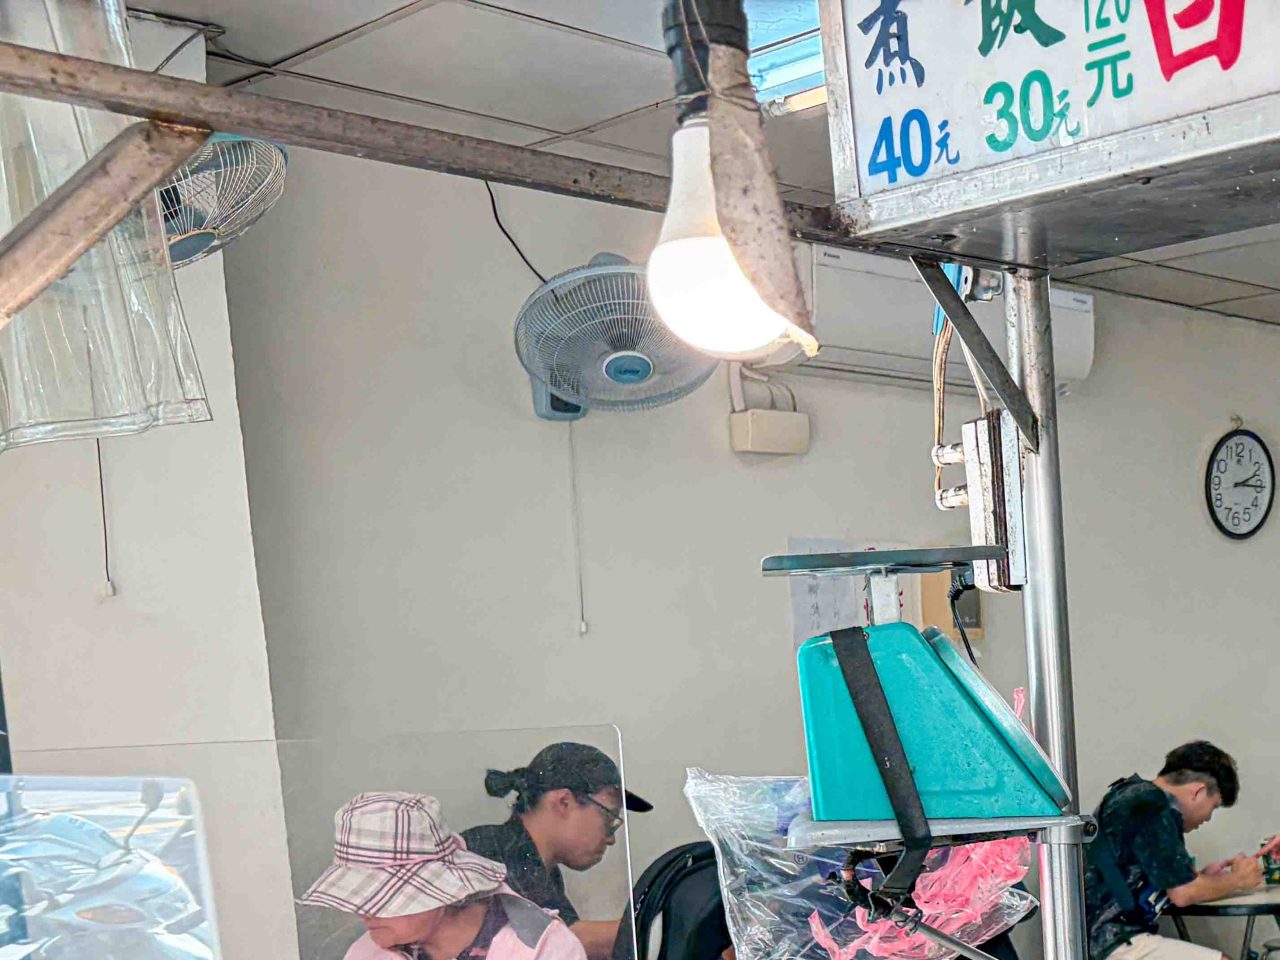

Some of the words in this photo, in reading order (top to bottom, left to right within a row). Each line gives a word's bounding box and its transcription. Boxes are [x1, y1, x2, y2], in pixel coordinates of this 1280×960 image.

[868, 108, 961, 184] 40元
[1234, 442, 1246, 459] 12
[1212, 475, 1221, 491] 9
[1214, 493, 1223, 508] 8
[1251, 496, 1259, 510] 4
[1232, 511, 1241, 527] 6
[1243, 508, 1252, 523] 5
